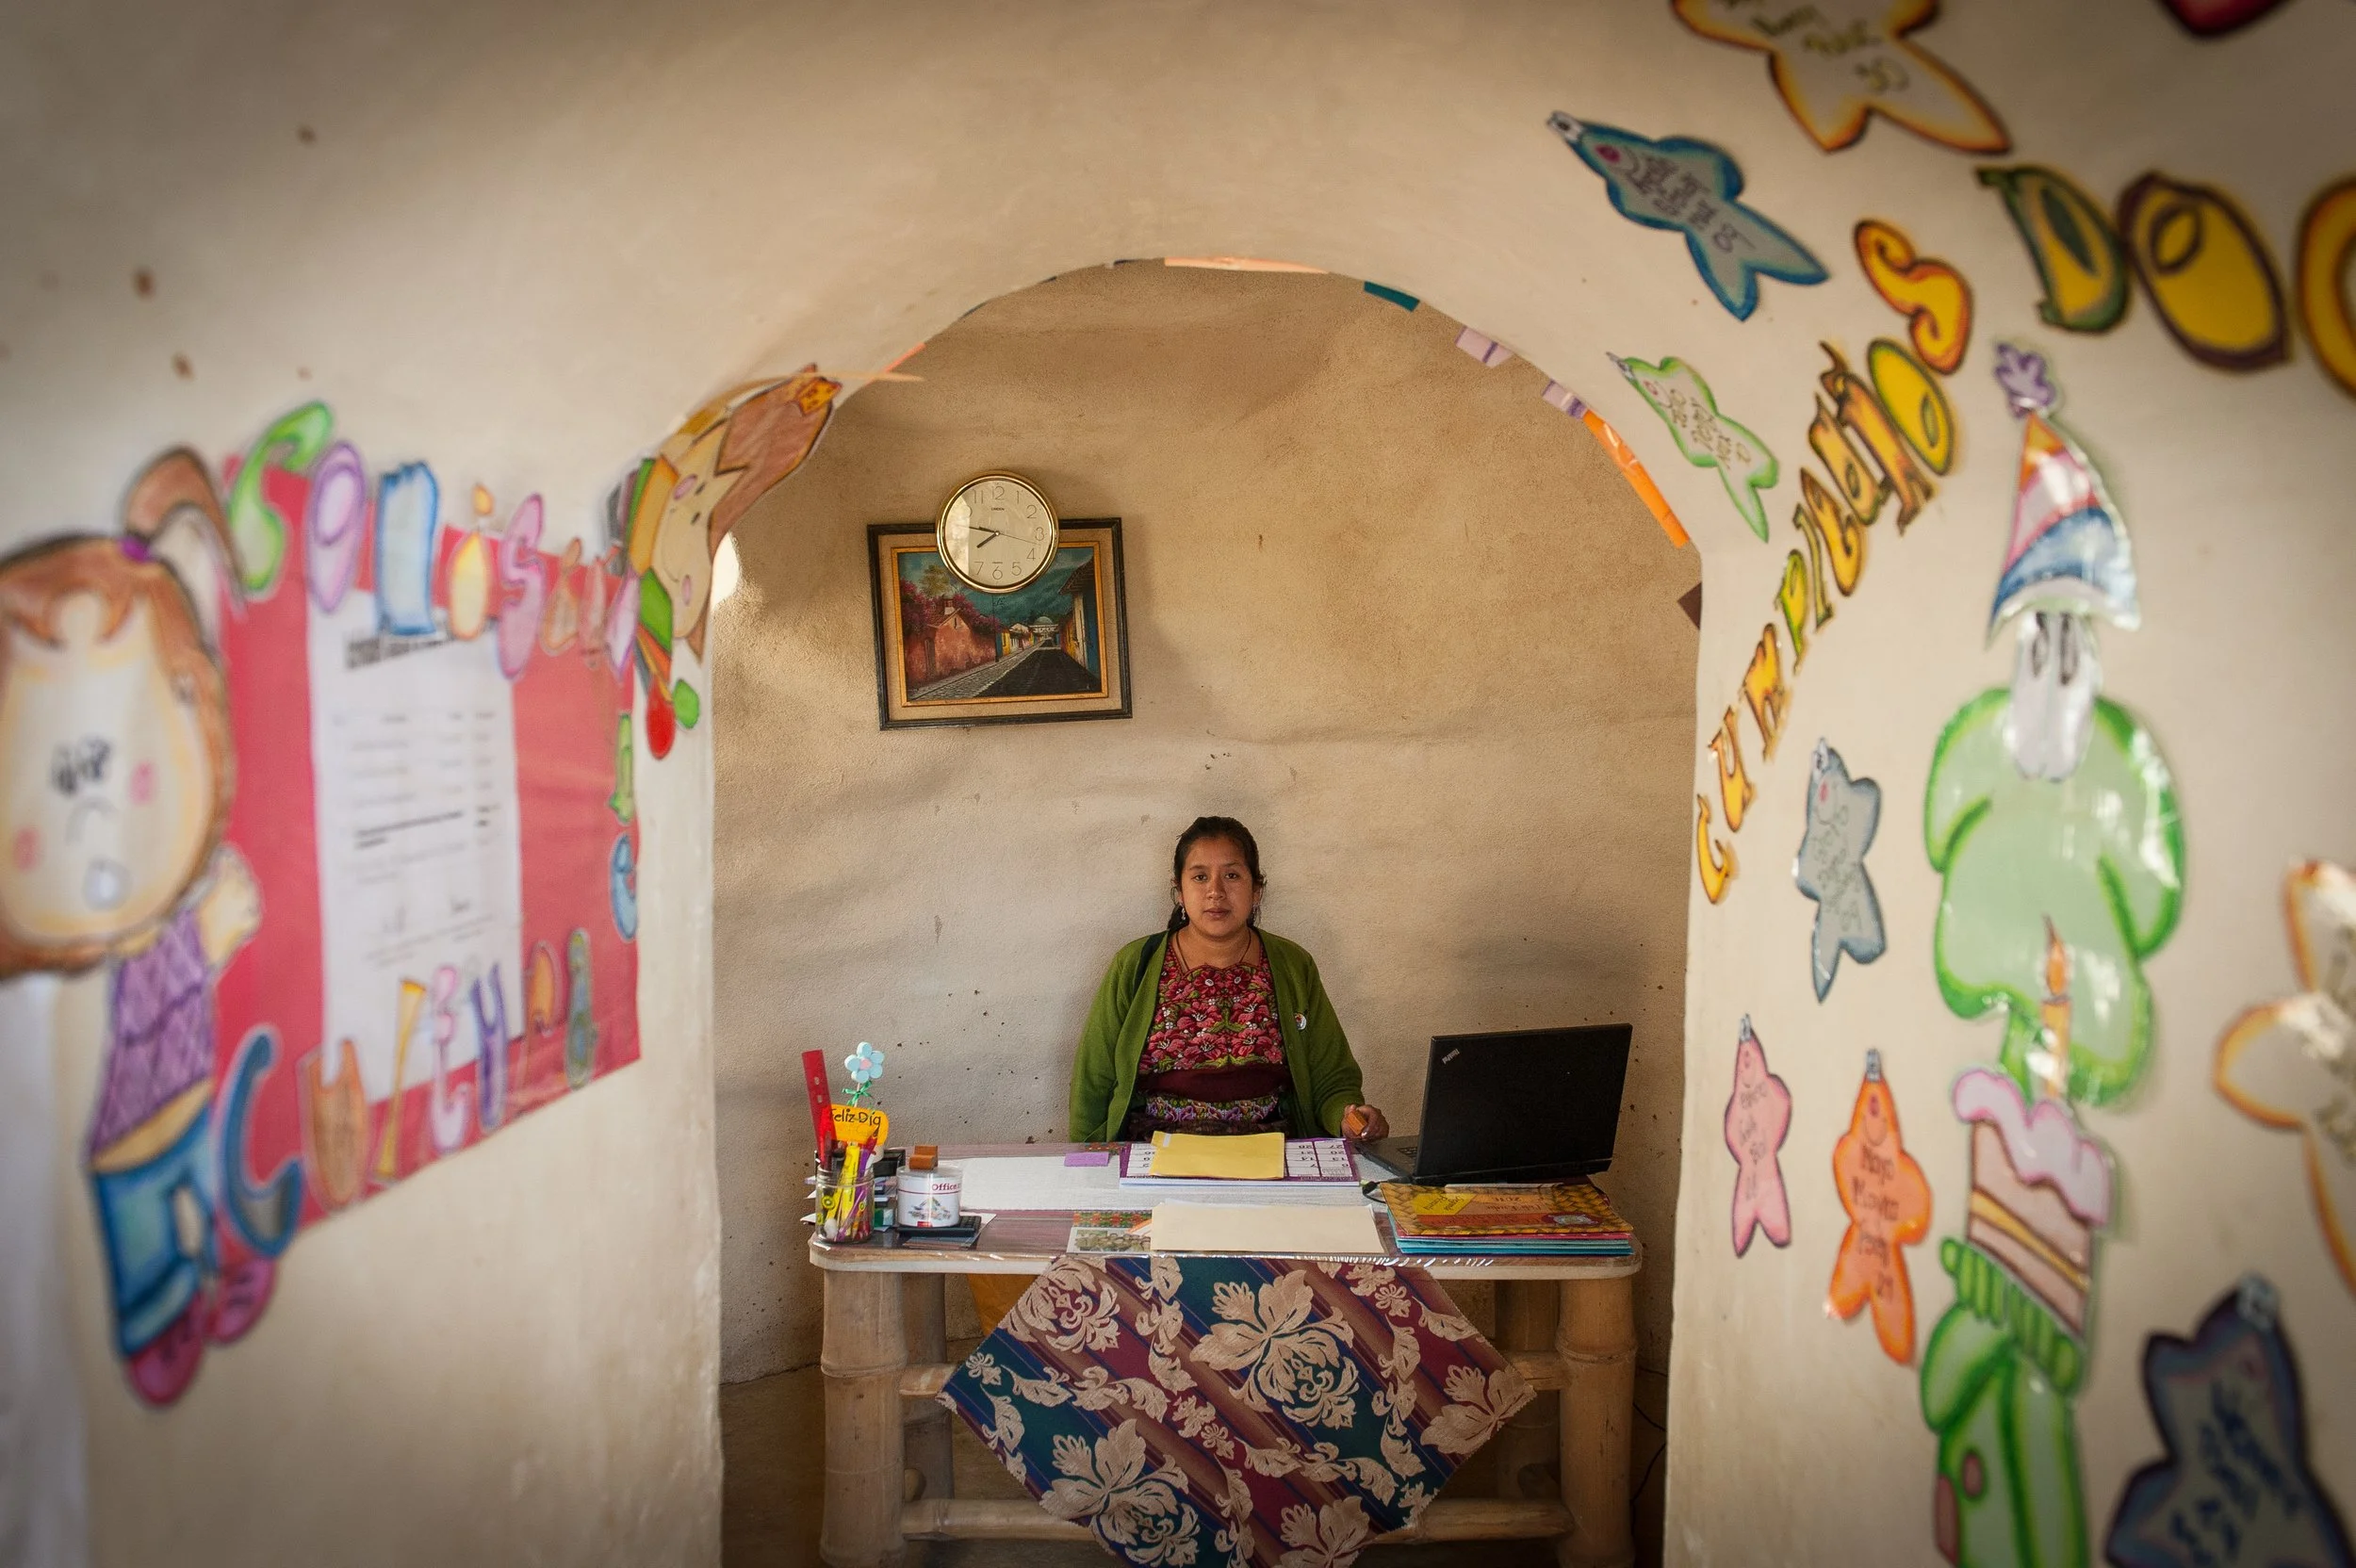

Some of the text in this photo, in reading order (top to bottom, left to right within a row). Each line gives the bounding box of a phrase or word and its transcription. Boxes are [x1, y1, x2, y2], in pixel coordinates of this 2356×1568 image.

[992, 485, 1006, 500] 12
[1026, 504, 1037, 518] 2
[1035, 526, 1044, 541] 3
[1026, 547, 1036, 561] 4
[974, 561, 1022, 580] 7 6 5
[931, 1183, 957, 1191] Office
